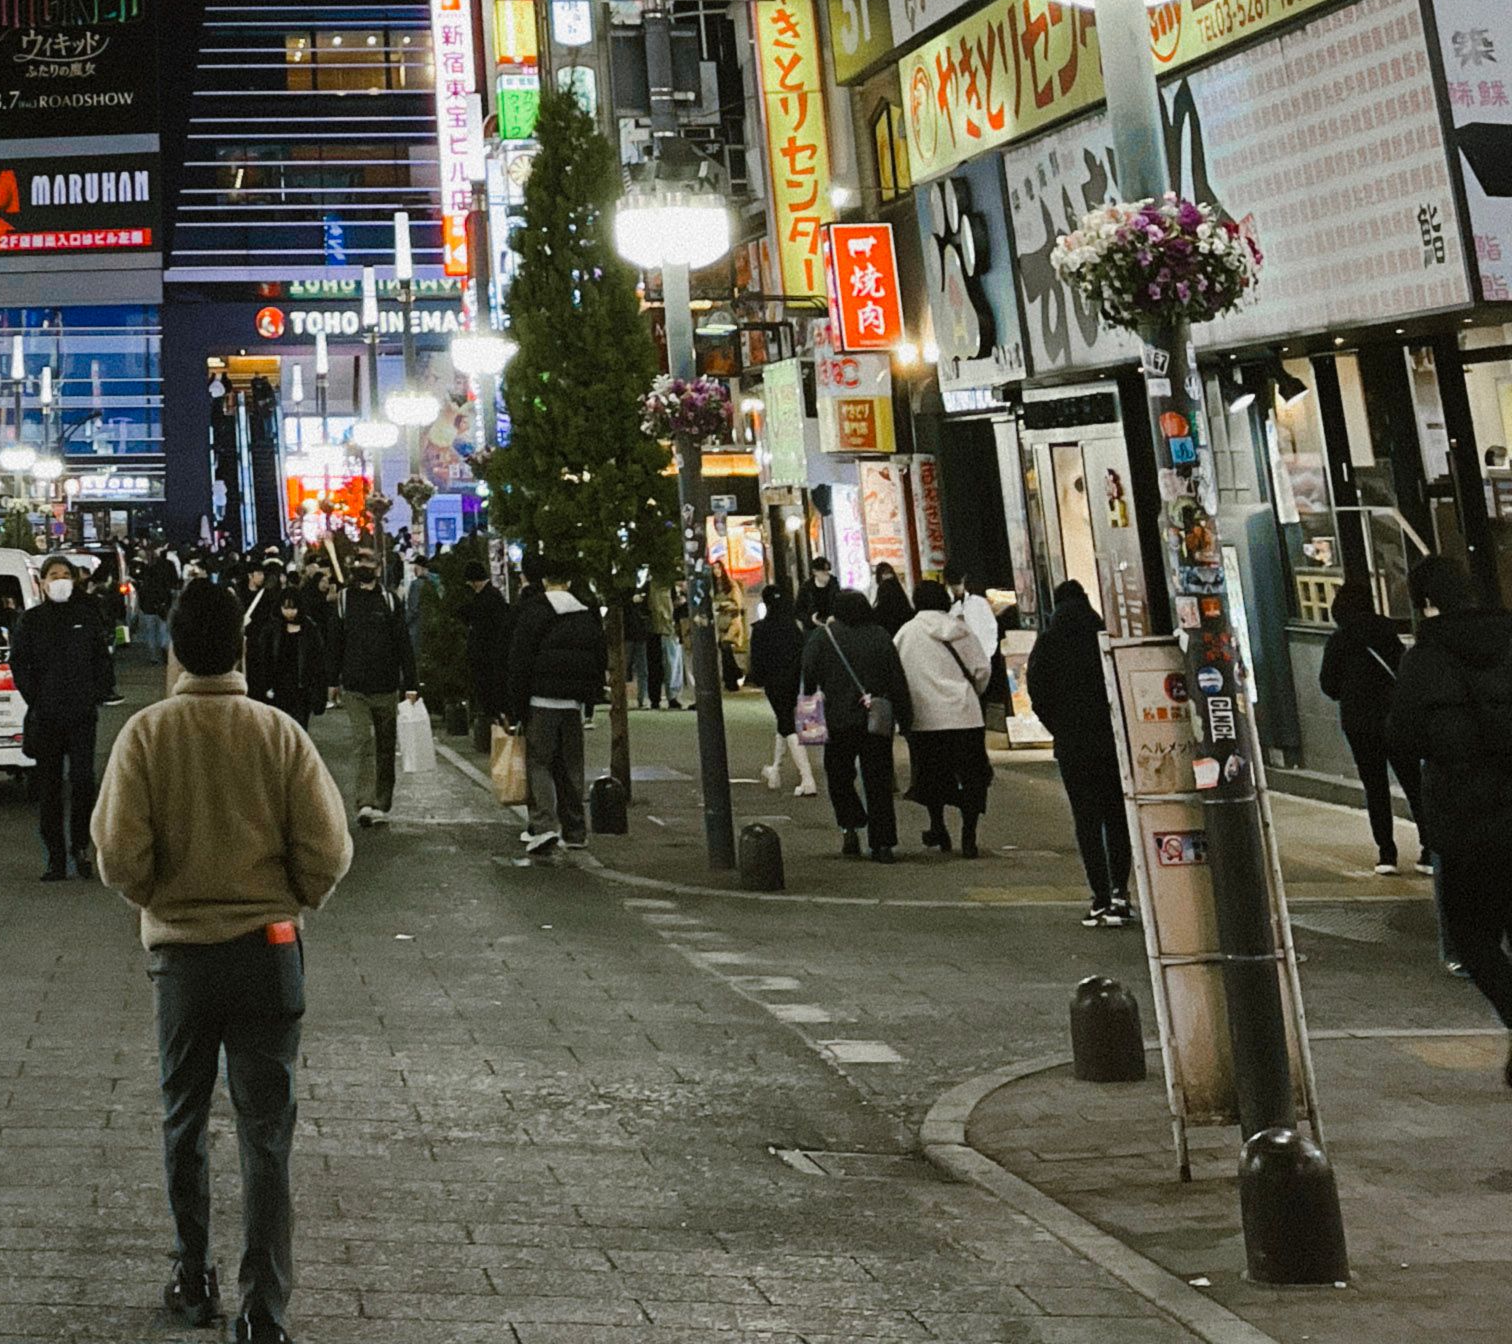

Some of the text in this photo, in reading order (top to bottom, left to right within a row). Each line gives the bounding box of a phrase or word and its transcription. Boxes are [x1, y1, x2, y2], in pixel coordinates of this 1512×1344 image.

[21, 29, 102, 60] ウィキッド
[25, 61, 97, 77] ふたりの魔女
[39, 91, 133, 108] ROADSHOW
[442, 26, 471, 209] 新宿東宝ビル店
[31, 171, 149, 205] MARUHAN
[850, 266, 886, 335] 焼肉
[289, 312, 359, 334] TOHO
